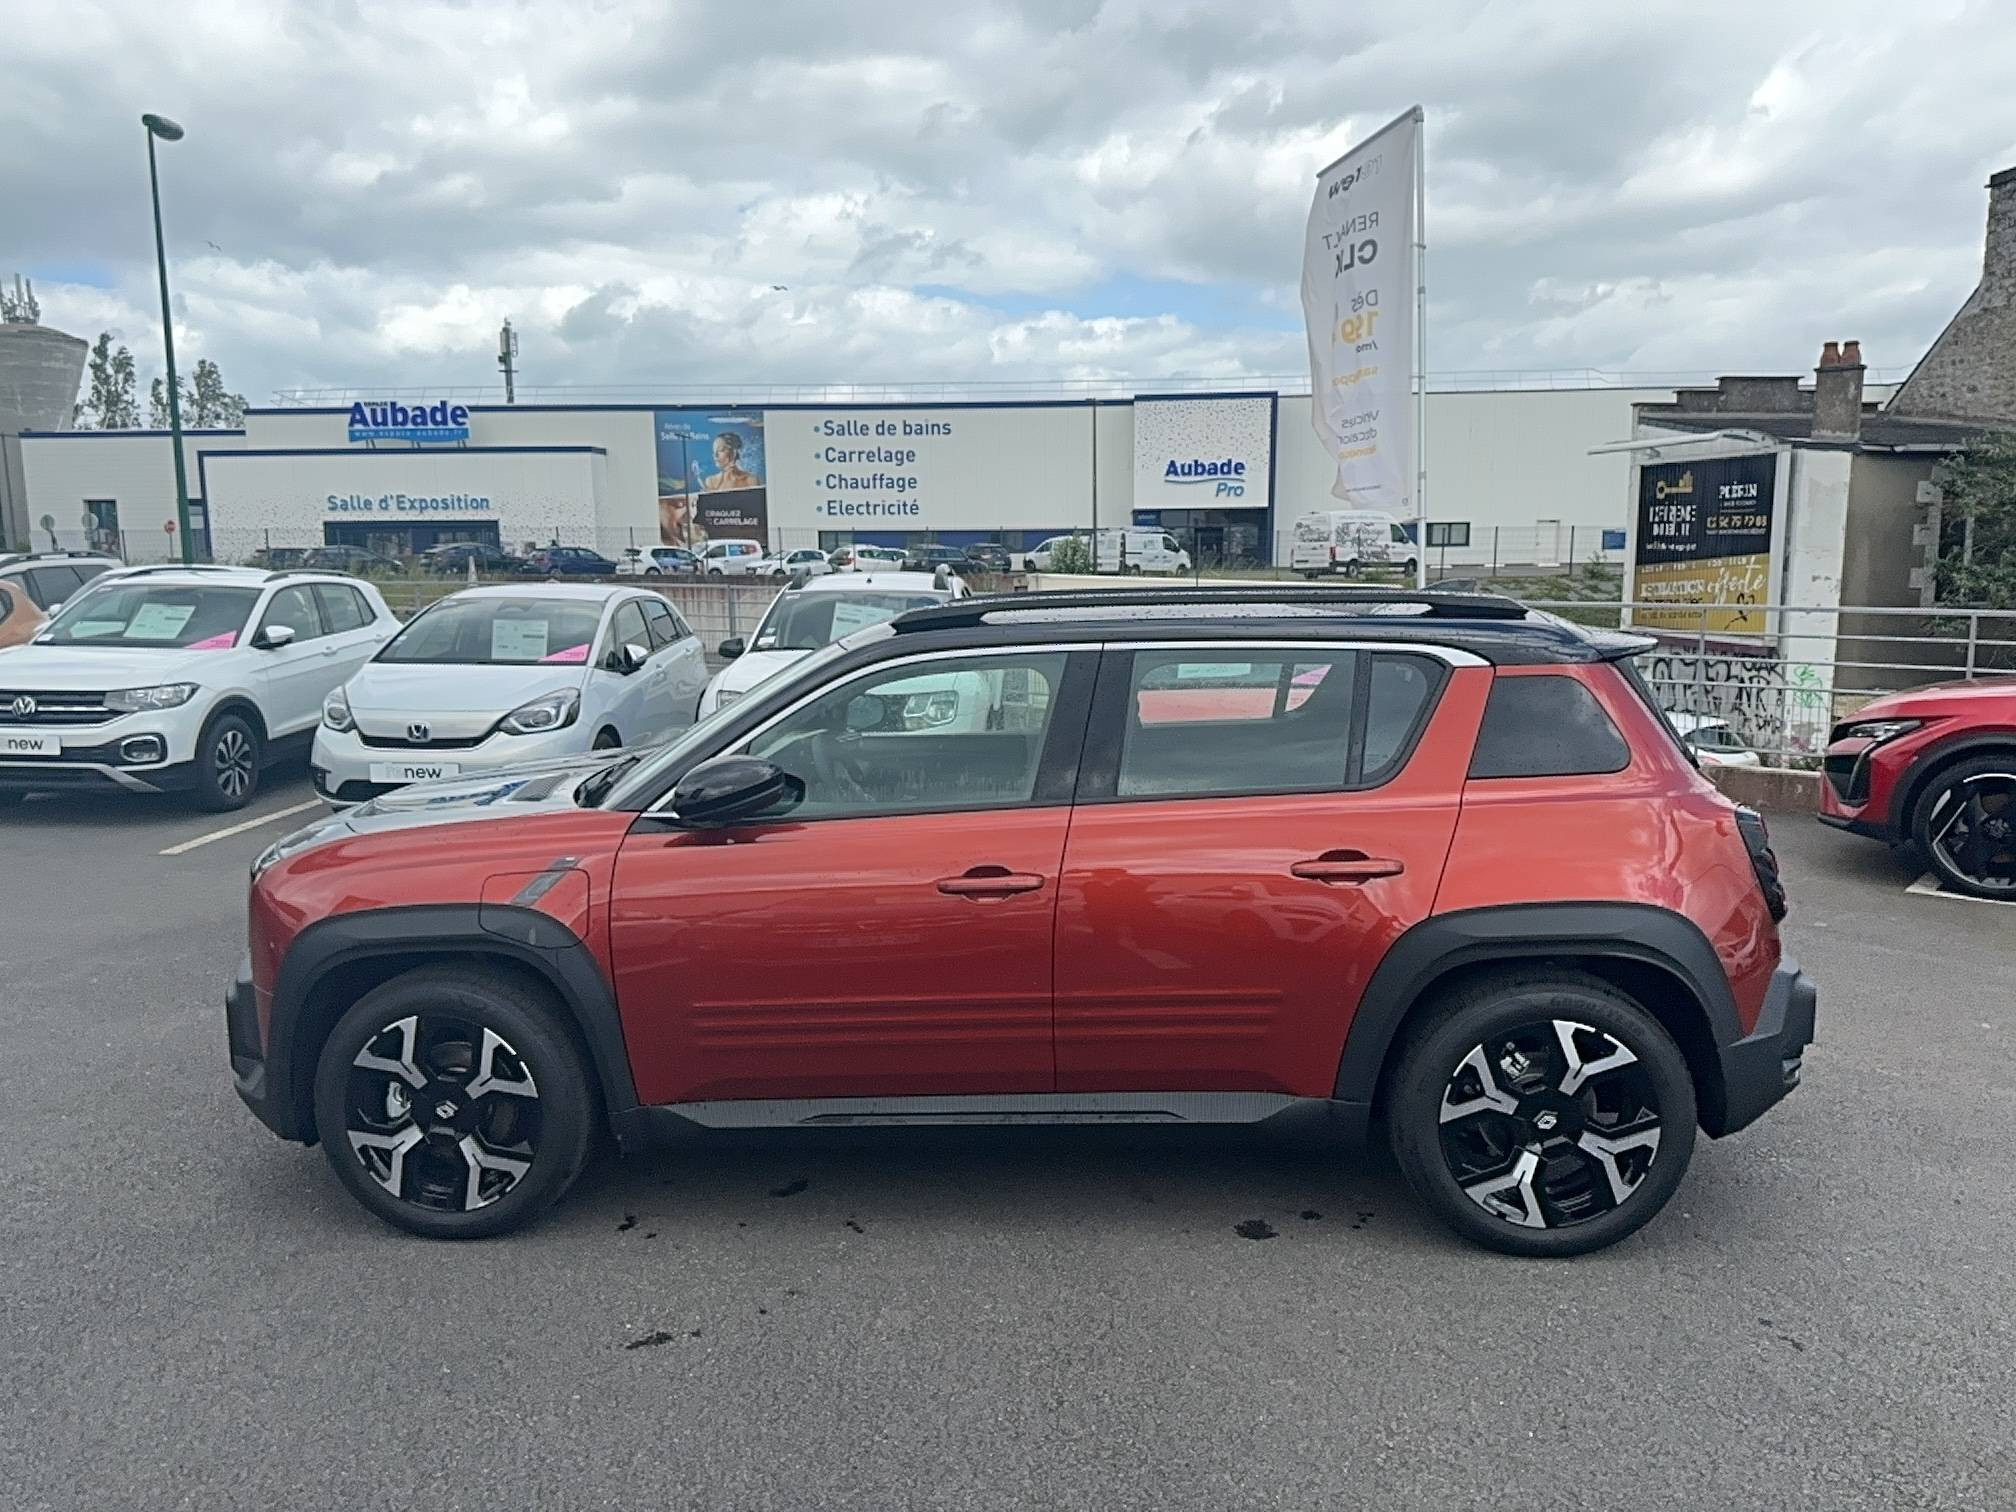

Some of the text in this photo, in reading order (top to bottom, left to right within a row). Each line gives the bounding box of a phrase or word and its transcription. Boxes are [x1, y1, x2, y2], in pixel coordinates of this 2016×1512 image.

[348, 400, 468, 427] Aubade
[824, 418, 952, 436] Salle de bains
[824, 446, 916, 466] Carrelage
[1164, 459, 1246, 476] Aubade
[826, 473, 918, 493] Chauffage
[1215, 482, 1245, 498] Pro
[327, 493, 490, 513] Salle d'Exposition
[827, 498, 920, 516] Electricité
